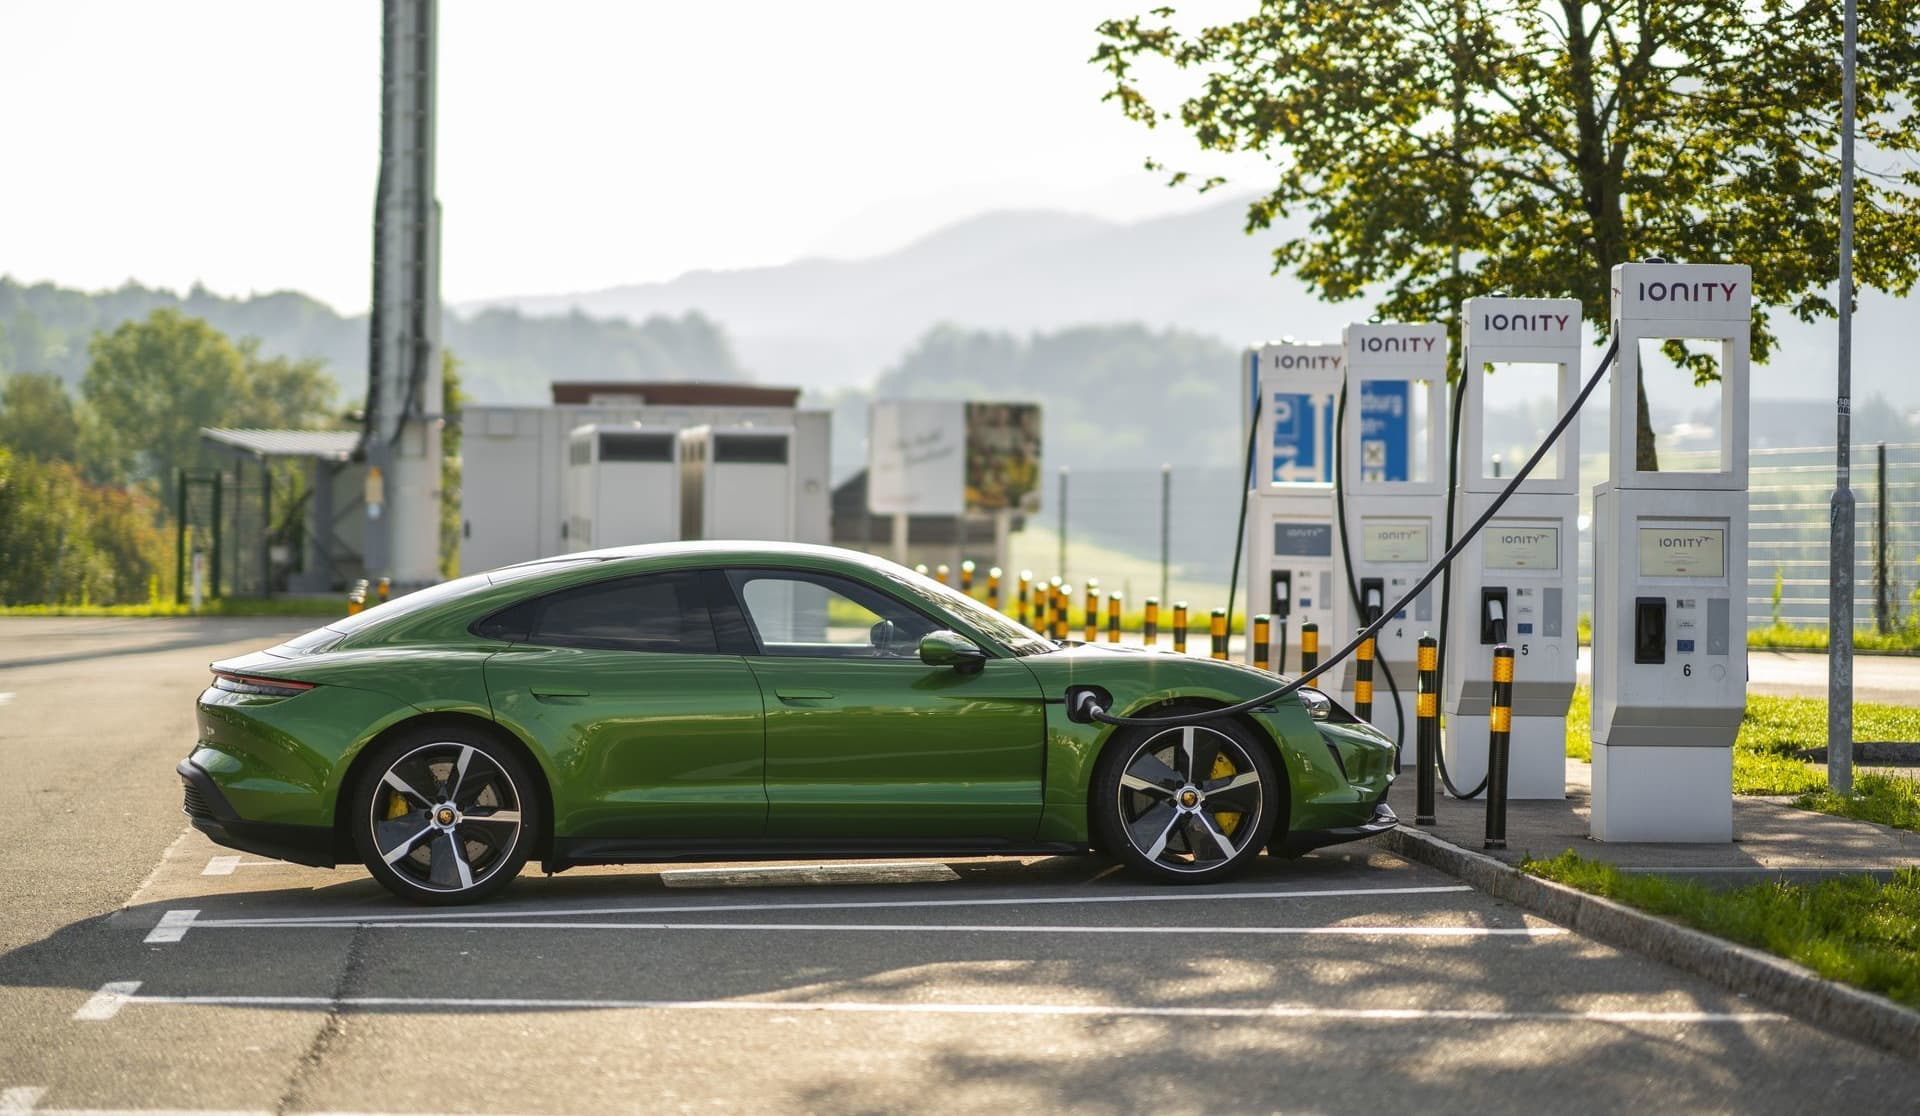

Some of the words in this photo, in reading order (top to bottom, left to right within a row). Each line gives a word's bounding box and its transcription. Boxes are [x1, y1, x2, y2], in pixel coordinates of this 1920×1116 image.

[1639, 282, 1737, 302] IONITY
[1484, 314, 1569, 331] IONITY
[1361, 337, 1436, 352] IONITY
[1275, 355, 1341, 369] IONITY
[1378, 531, 1412, 541] IONITY
[1502, 535, 1540, 544] IONITY
[1659, 537, 1704, 548] IONITY
[1396, 628, 1402, 638] 4
[1521, 644, 1529, 656] 5
[1683, 664, 1691, 677] 6
